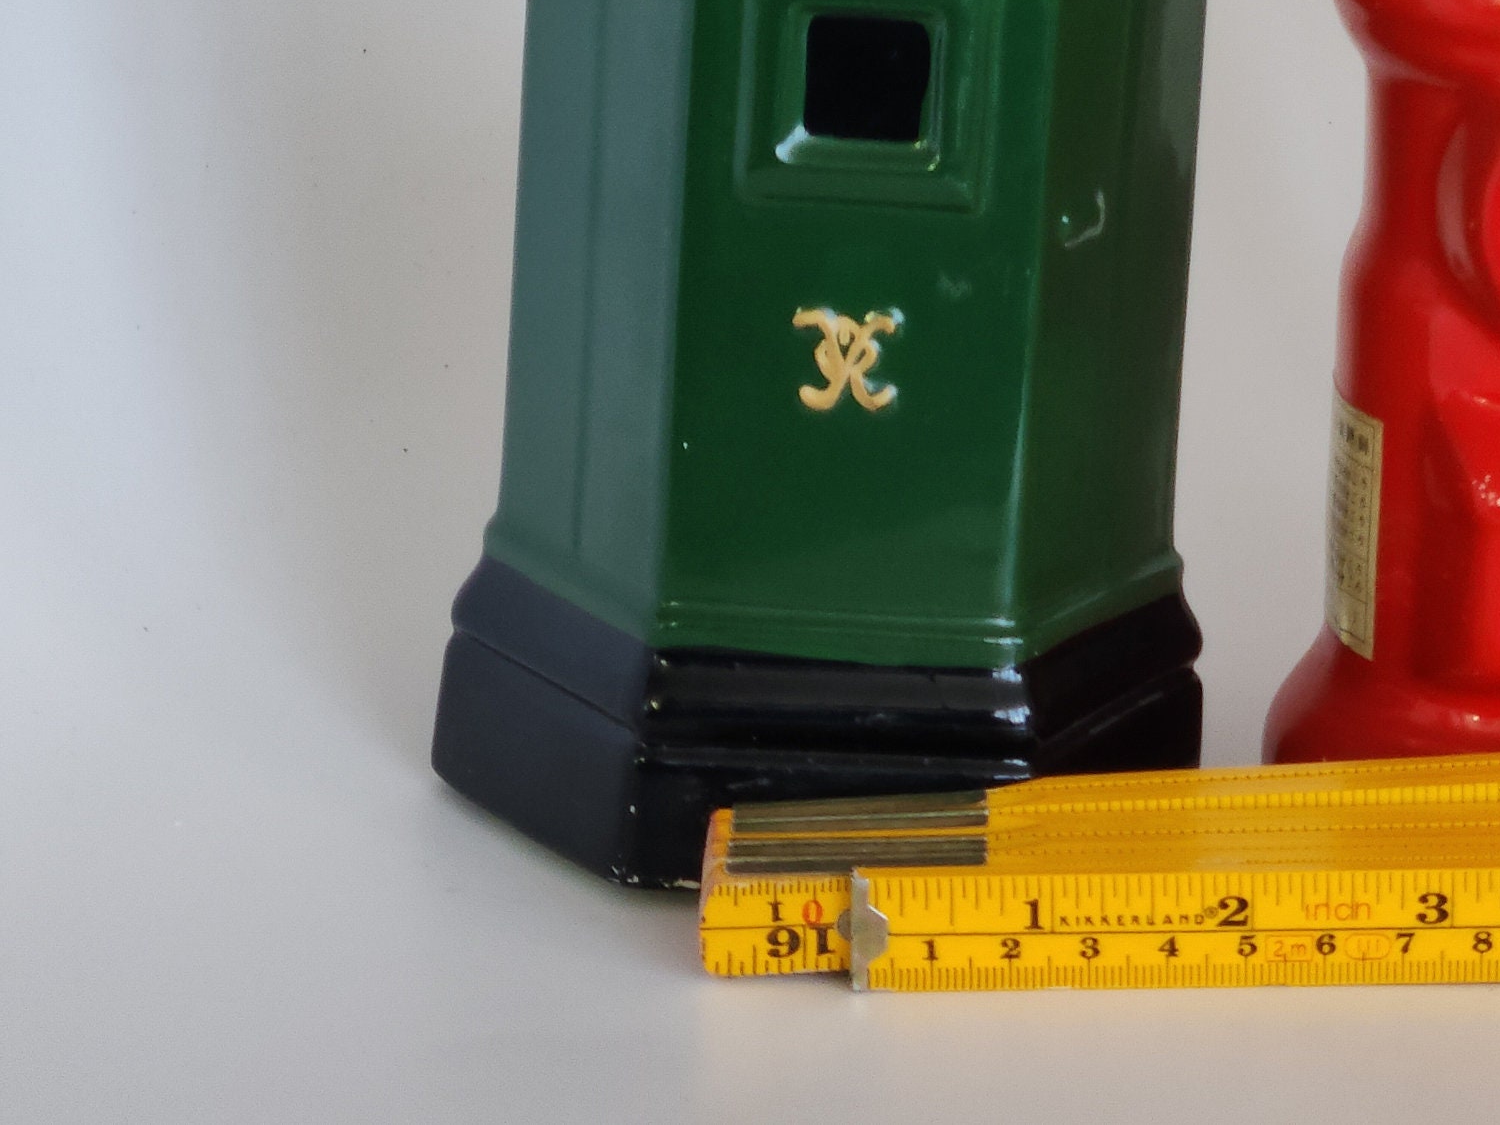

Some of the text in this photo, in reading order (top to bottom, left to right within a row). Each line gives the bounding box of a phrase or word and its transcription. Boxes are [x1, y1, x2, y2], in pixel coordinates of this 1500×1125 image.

[1023, 898, 1045, 931] 1
[1217, 896, 1249, 927] 2
[1416, 892, 1450, 924] 3
[1304, 901, 1372, 922] inch
[923, 940, 939, 961] 1
[1000, 938, 1021, 959] 2
[1079, 936, 1101, 959] 3
[1158, 936, 1179, 957] 4
[1238, 935, 1258, 957] 5
[1316, 933, 1337, 955] 6
[1396, 933, 1415, 955] 7
[1472, 931, 1493, 954] 8
